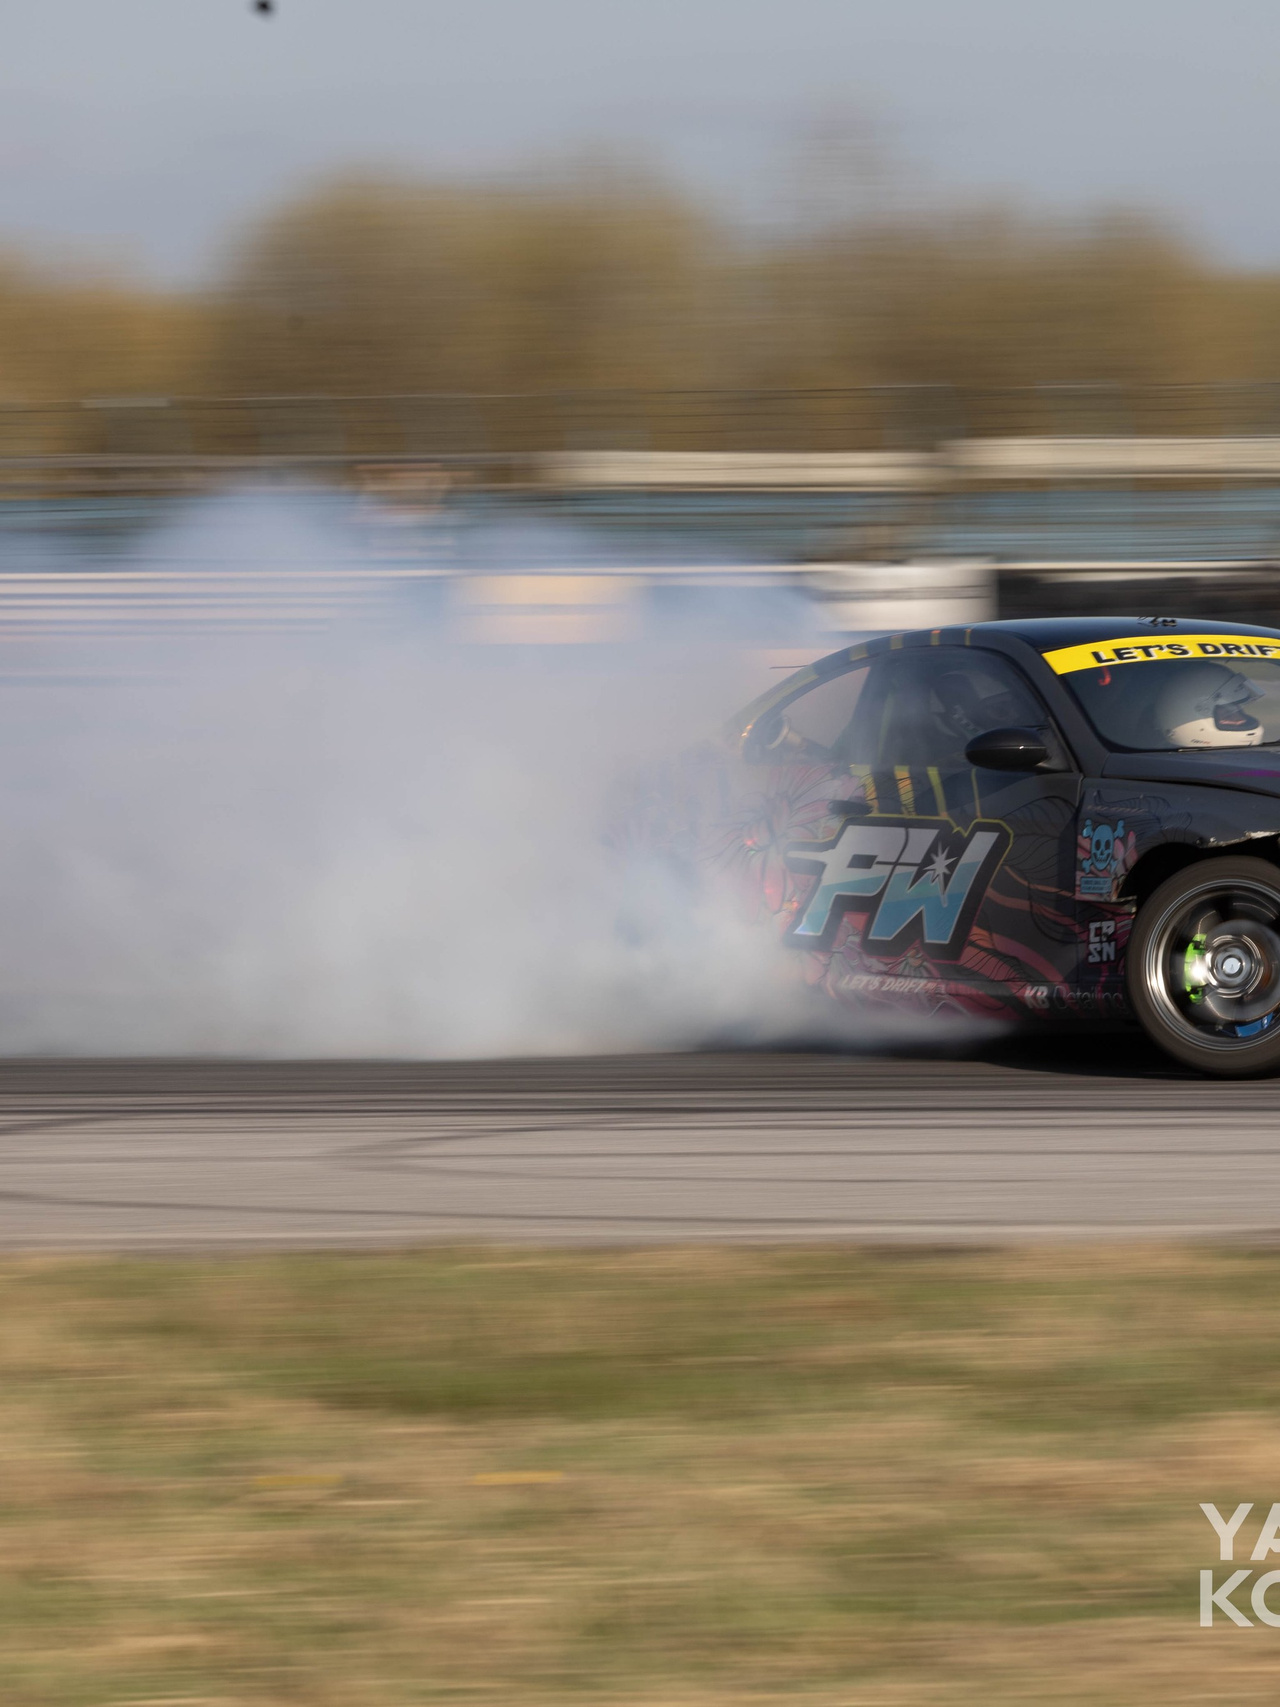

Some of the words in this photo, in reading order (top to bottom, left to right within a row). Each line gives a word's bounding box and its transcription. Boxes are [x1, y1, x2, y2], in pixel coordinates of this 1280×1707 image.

[1092, 643, 1191, 665] LET'S
[841, 975, 880, 991] LET'S
[881, 977, 928, 994] DRIFT
[1024, 986, 1050, 1009] KB
[1053, 985, 1126, 1013] Detailing
